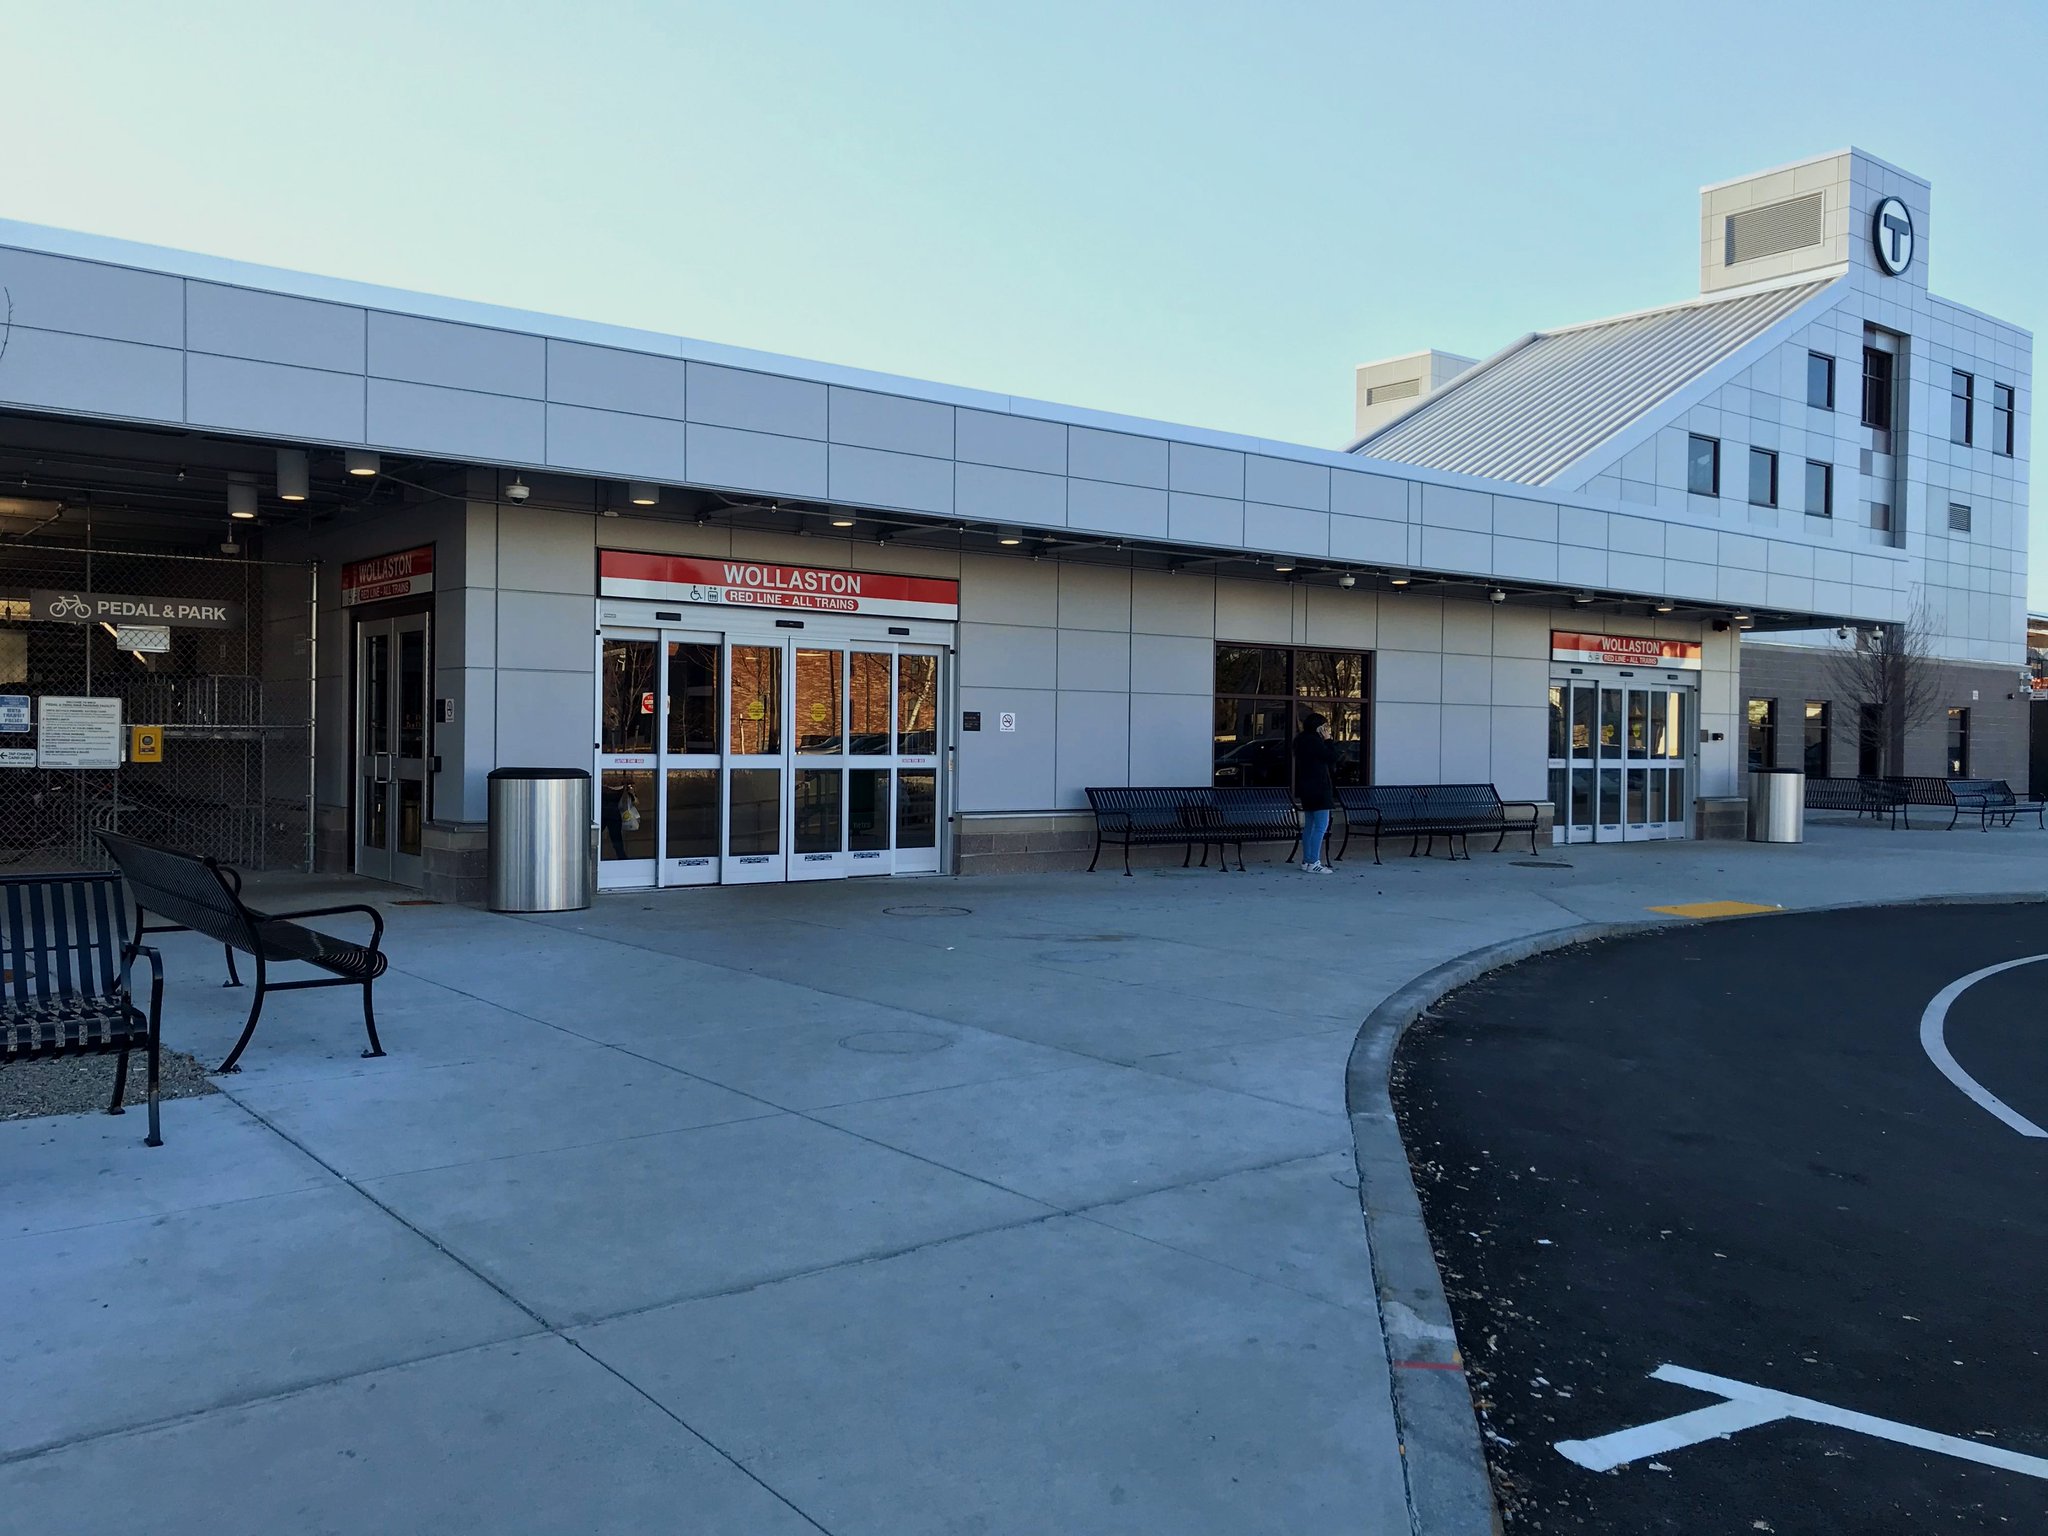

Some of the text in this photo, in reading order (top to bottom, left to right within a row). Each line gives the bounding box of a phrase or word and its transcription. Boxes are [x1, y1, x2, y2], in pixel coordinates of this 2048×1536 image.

[1884, 213, 1909, 262] T
[359, 554, 412, 583] WOLLASTON
[723, 564, 861, 594] WOLLASTON
[361, 589, 369, 599] RED
[370, 587, 380, 598] LINE
[383, 585, 391, 596] ALL
[392, 582, 409, 595] TRAINS
[97, 600, 226, 621] PEDAL & PARK
[730, 592, 754, 602] RED
[757, 594, 782, 604] LINE
[792, 597, 812, 607] ALL
[815, 598, 854, 610] TRAINS
[1602, 637, 1659, 654] WOLLASTON
[1615, 655, 1626, 663] LINE
[1639, 657, 1657, 665] TRAINS
